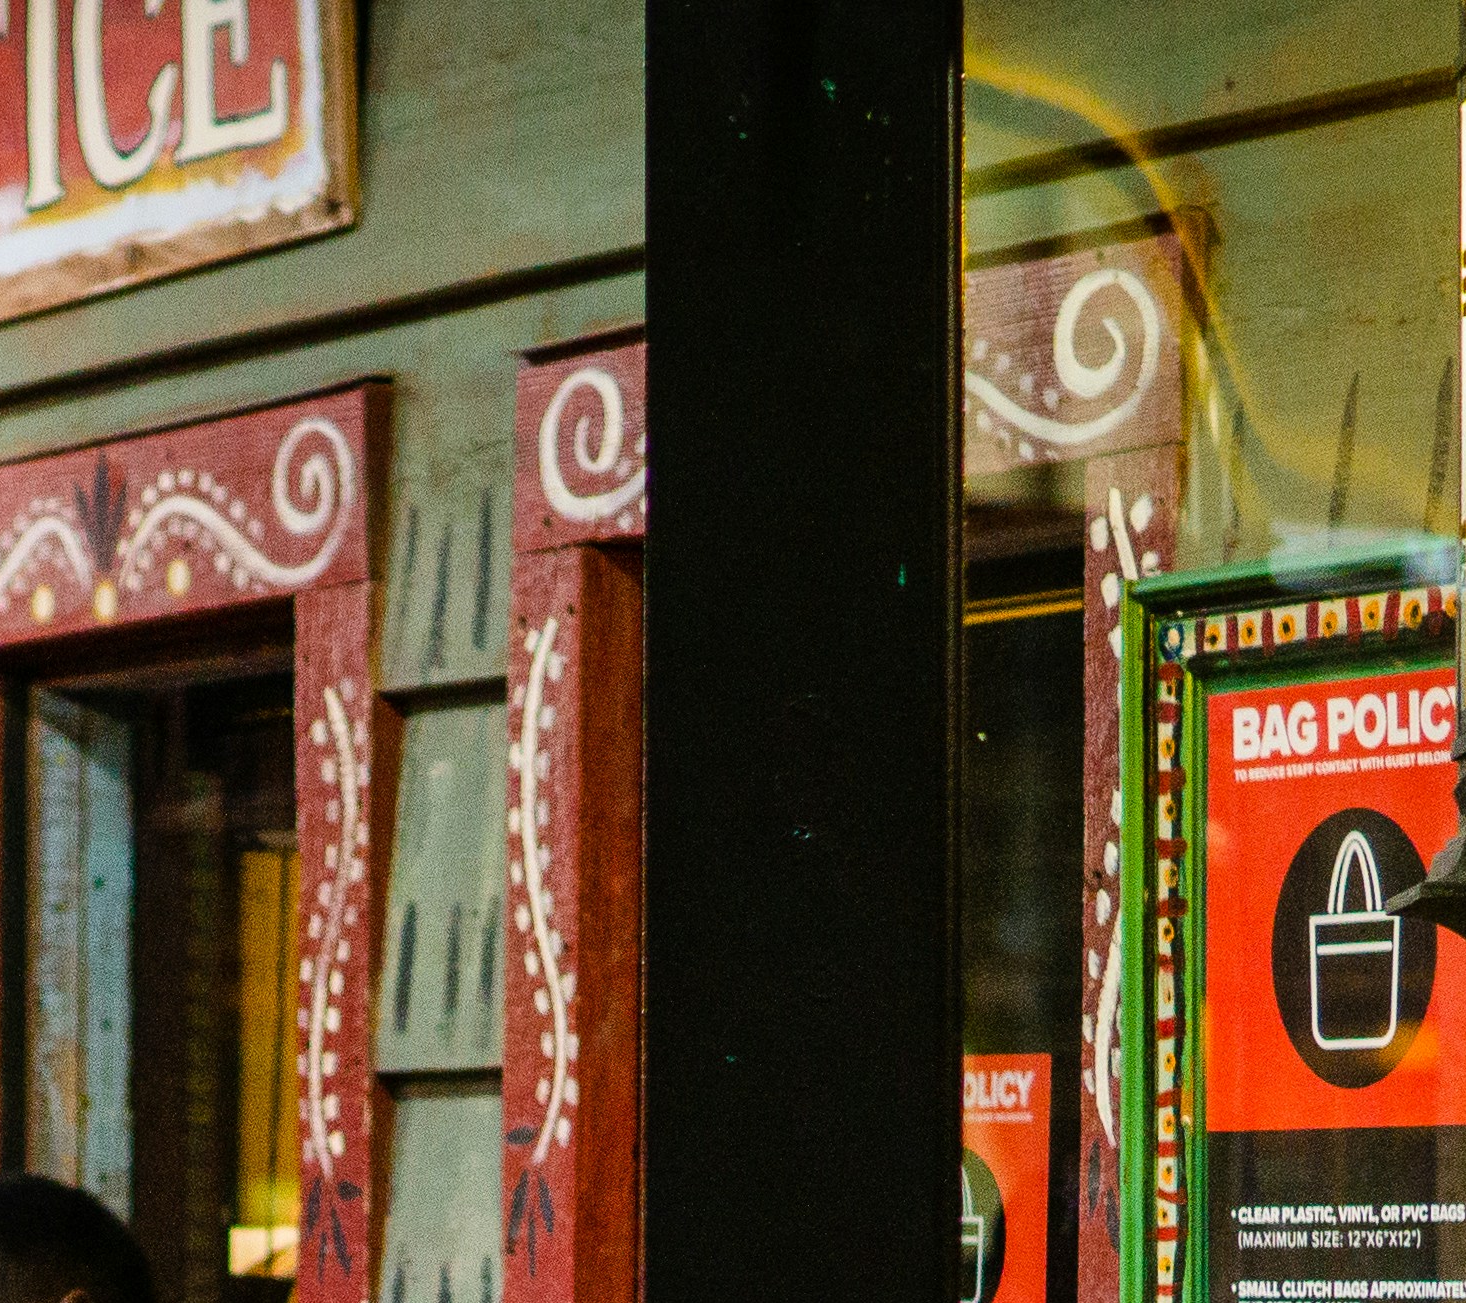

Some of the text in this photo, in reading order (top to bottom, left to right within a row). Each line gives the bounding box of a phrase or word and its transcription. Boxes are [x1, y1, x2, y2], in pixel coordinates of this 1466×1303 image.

[1232, 686, 1456, 762] BAG POLIC
[1234, 768, 1248, 783] TO
[963, 1070, 1036, 1108] OLICY
[1238, 1204, 1466, 1226] CLEAR PLASTIC, VINYL, OR PVC BAGS
[1238, 1230, 1308, 1250] (MAXIMUM
[1311, 1230, 1344, 1249] SIZE:
[1238, 1281, 1280, 1299] SMALL
[1281, 1281, 1332, 1298] CLUTCH
[1334, 1281, 1369, 1298] BAGS
